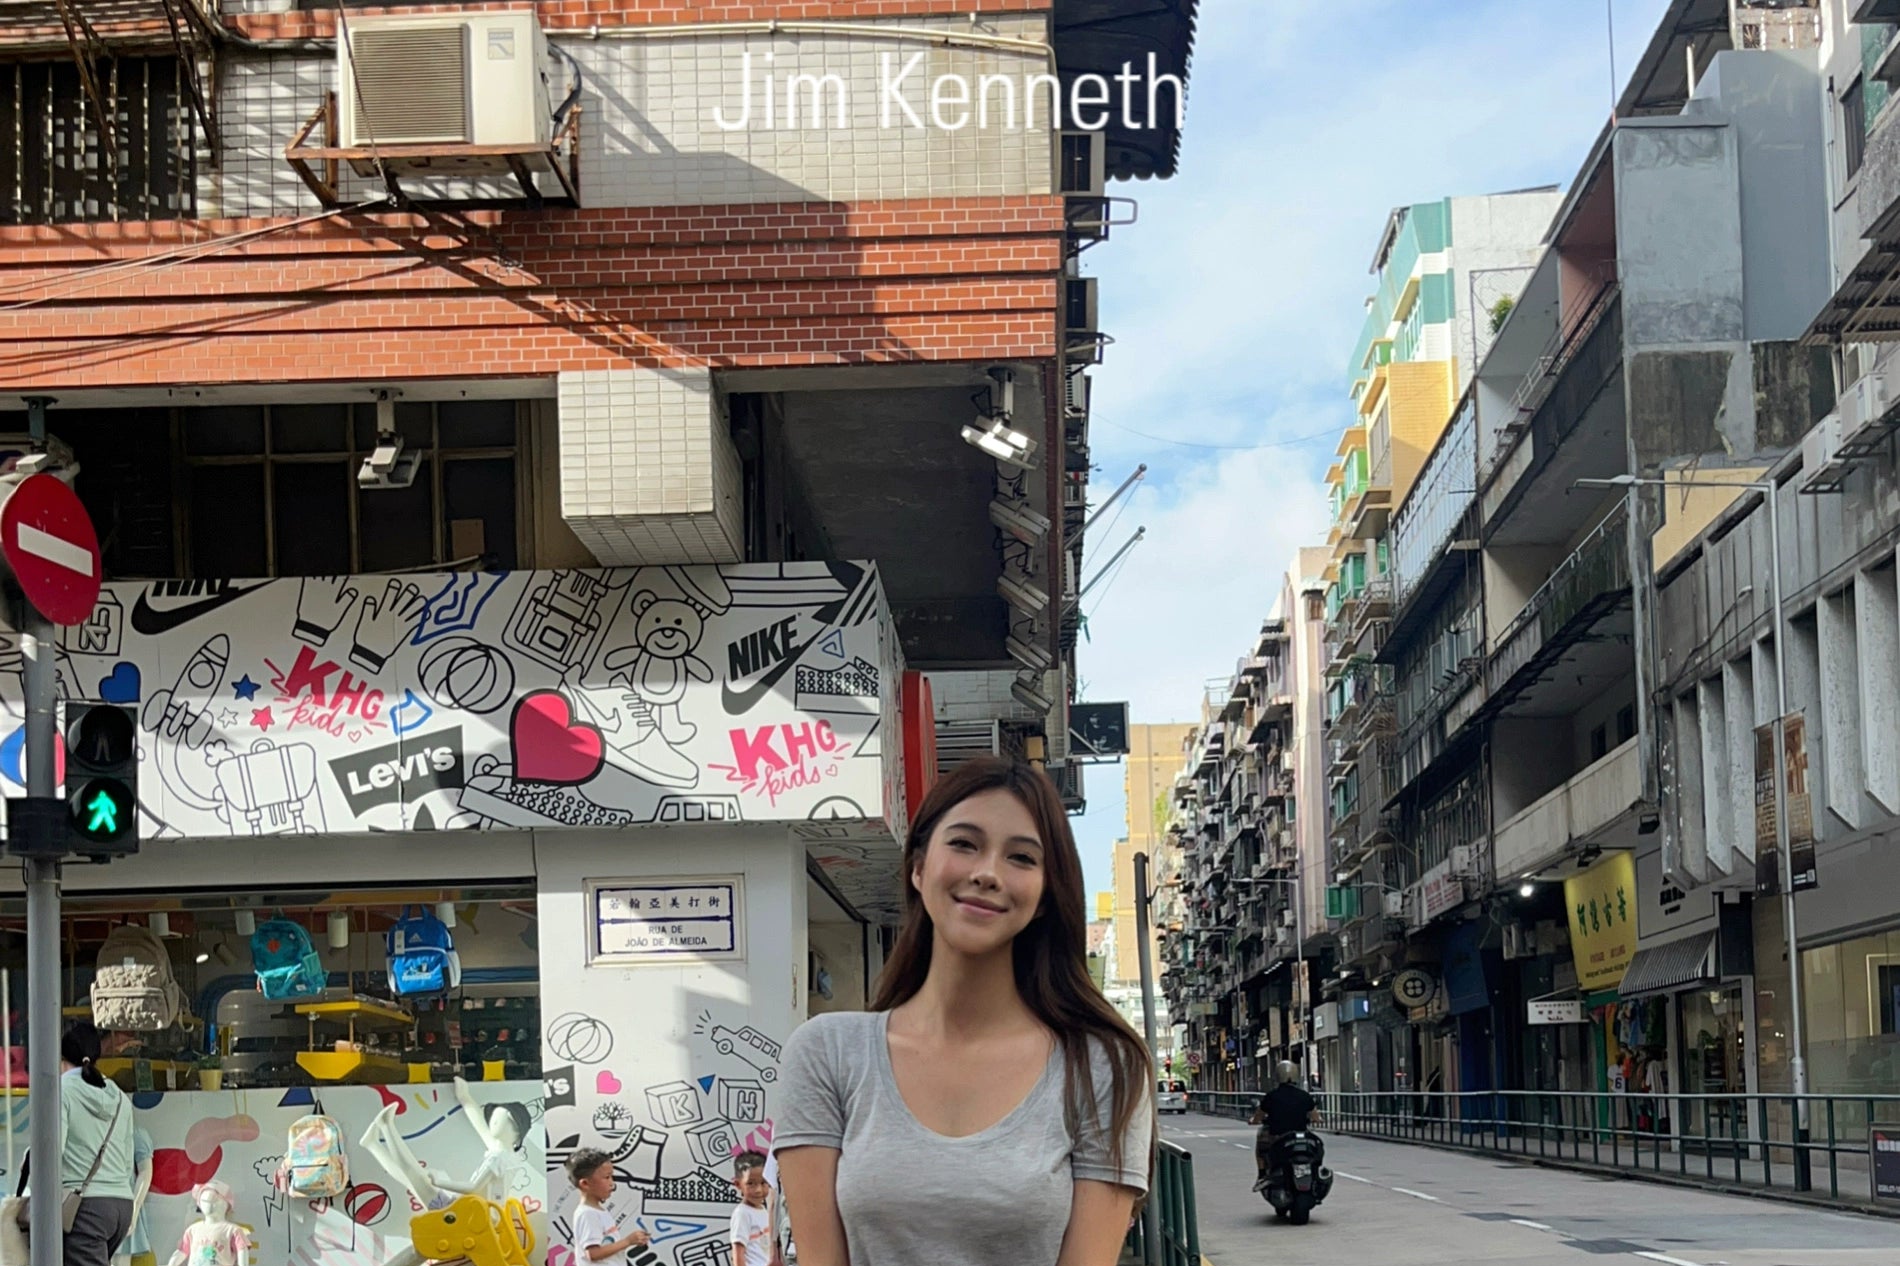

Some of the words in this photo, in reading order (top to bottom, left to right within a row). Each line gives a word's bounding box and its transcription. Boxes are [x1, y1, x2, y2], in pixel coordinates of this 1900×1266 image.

[728, 614, 801, 682] NIKE
[284, 644, 384, 720] KHG
[282, 693, 346, 737] kids
[347, 746, 456, 796] Levi's
[728, 718, 837, 781] KHG
[756, 753, 821, 808] kids
[625, 937, 648, 947] JOÃO
[652, 938, 664, 947] DE
[668, 936, 708, 947] ALMEIDA
[648, 925, 667, 935] RUA
[671, 925, 683, 934] DE
